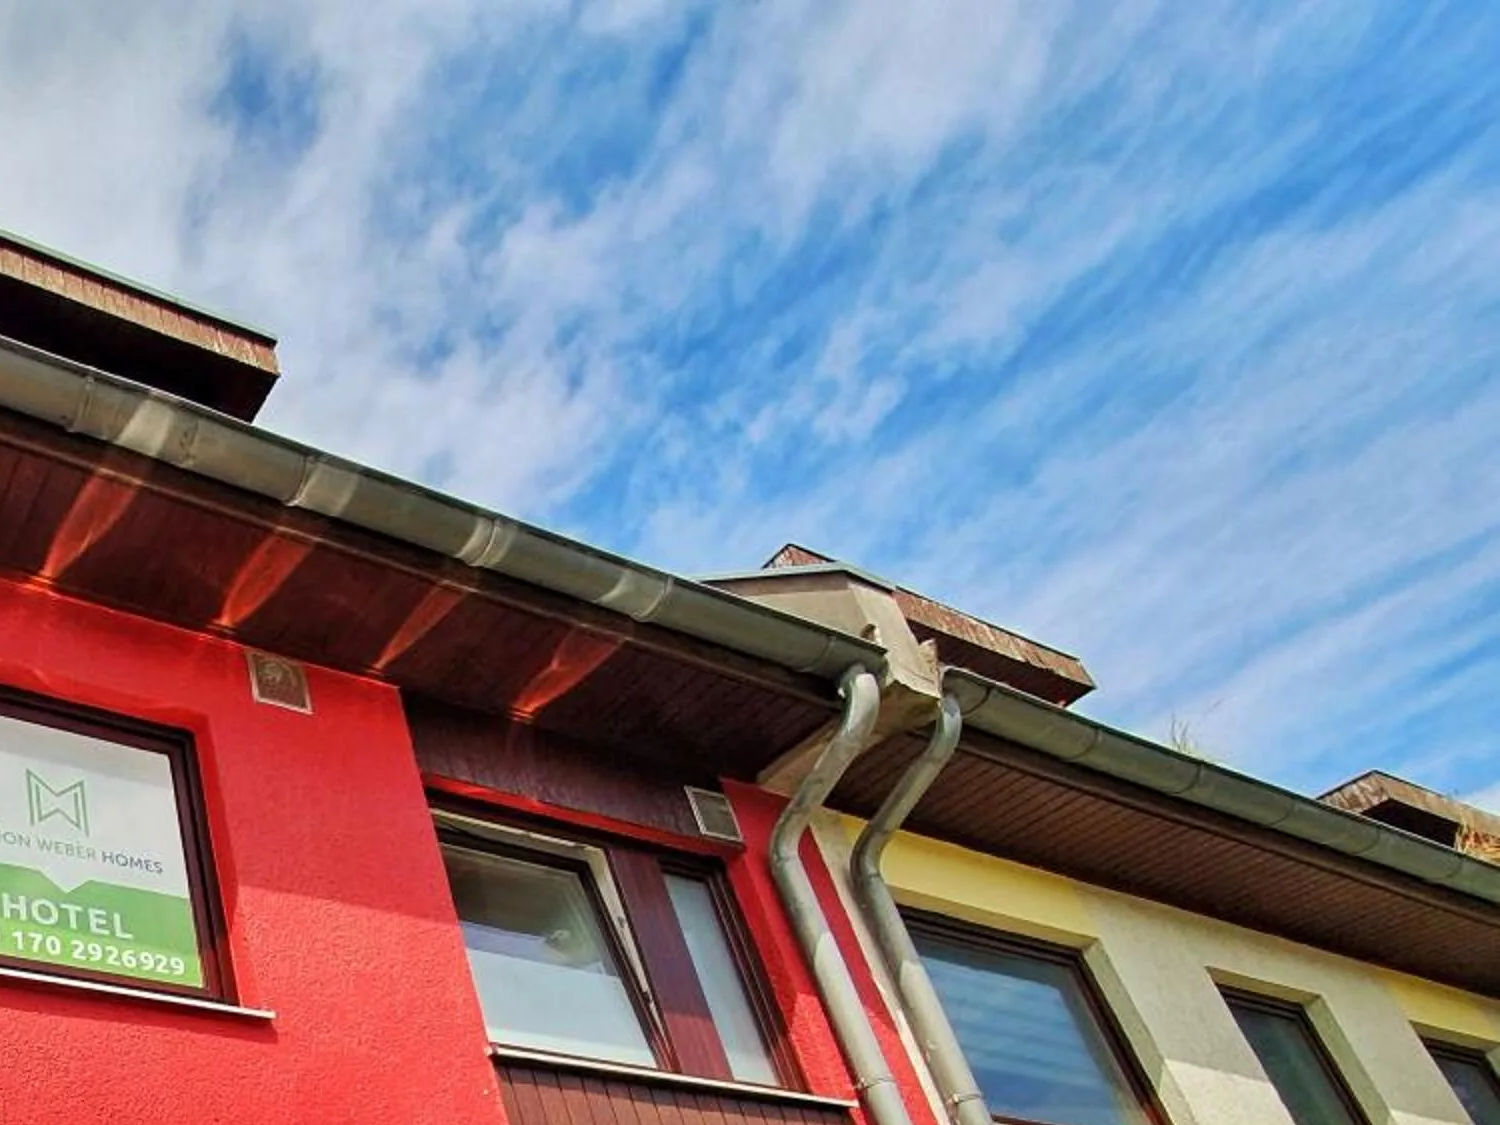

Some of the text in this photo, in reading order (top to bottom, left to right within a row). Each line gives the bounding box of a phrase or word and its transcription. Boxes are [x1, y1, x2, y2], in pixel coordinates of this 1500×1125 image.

[37, 837, 97, 862] WEBER
[101, 851, 165, 875] HOMES
[1, 892, 134, 941] HOTEL
[12, 930, 62, 956] 170
[71, 940, 186, 976] 2926929
